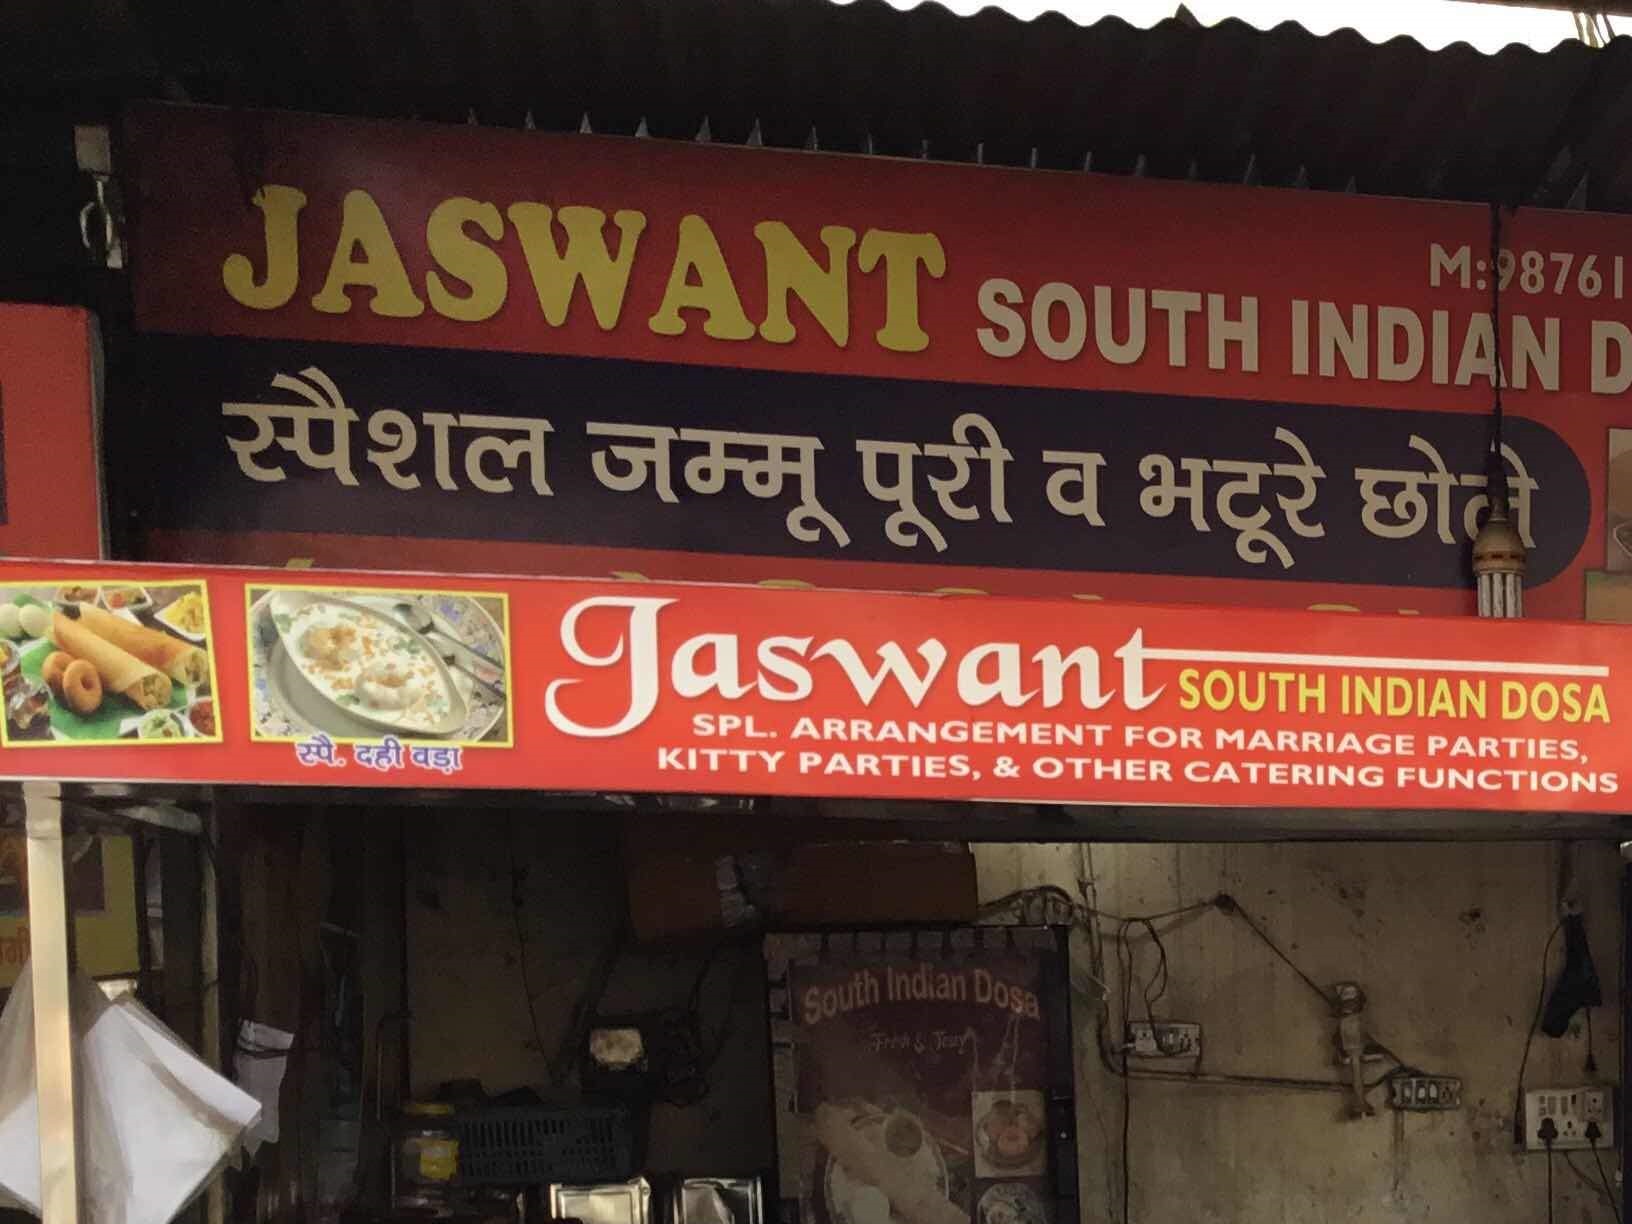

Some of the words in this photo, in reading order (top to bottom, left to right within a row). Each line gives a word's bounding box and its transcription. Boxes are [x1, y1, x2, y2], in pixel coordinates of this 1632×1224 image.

[222, 184, 947, 352] JASWANT
[976, 278, 1259, 372] SOUTH
[1291, 299, 1560, 392] INDIAN
[222, 366, 553, 497] स्पैशल
[586, 421, 850, 548] जम्मू
[856, 412, 1013, 552] पूरी
[1042, 450, 1105, 526] व
[1138, 427, 1326, 569] भटूरे
[544, 594, 1167, 738] Jaswant
[1178, 668, 1326, 714] SOUTH
[1341, 676, 1486, 720] INDIAN
[1501, 680, 1611, 723] DOSA
[353, 738, 406, 771] दही
[692, 714, 777, 738] SPL.
[791, 717, 1111, 746] ARRANGEMENT
[1125, 725, 1204, 748] FOR
[1215, 729, 1417, 756] MARRIAGE
[1428, 735, 1589, 764] PARTIES,
[657, 747, 782, 774] KITTY
[798, 752, 981, 782] PARTIES,
[995, 755, 1021, 779] &
[1033, 757, 1172, 783] OTHER
[1184, 761, 1386, 789] CATERING
[1397, 766, 1619, 794] FUNCTIONS
[803, 969, 880, 1025] South
[886, 963, 967, 1001] Indian
[970, 968, 1040, 1022] Dosa
